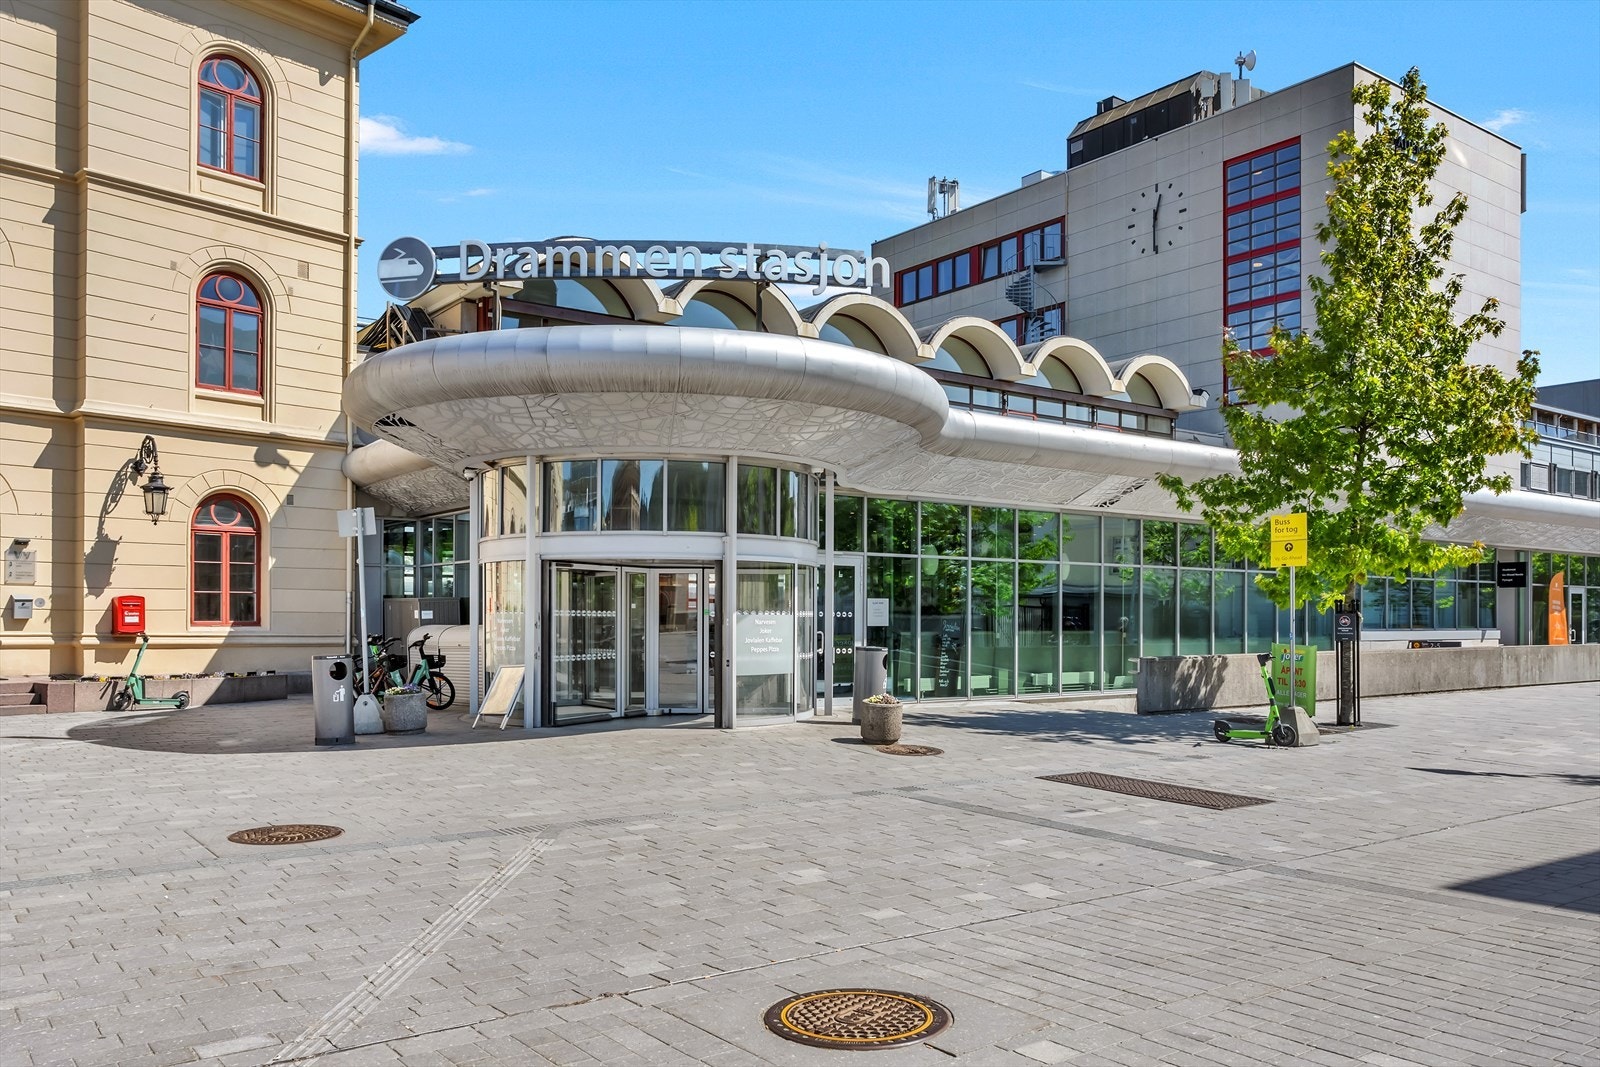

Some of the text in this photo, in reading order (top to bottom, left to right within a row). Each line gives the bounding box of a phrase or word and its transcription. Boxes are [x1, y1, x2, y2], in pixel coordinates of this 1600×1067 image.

[460, 240, 890, 295] Drammen stasjon
[1286, 526, 1298, 534] tog
[1281, 653, 1303, 663] joer
[1280, 664, 1303, 676] ÅPNT
[1277, 677, 1289, 686] TIL
